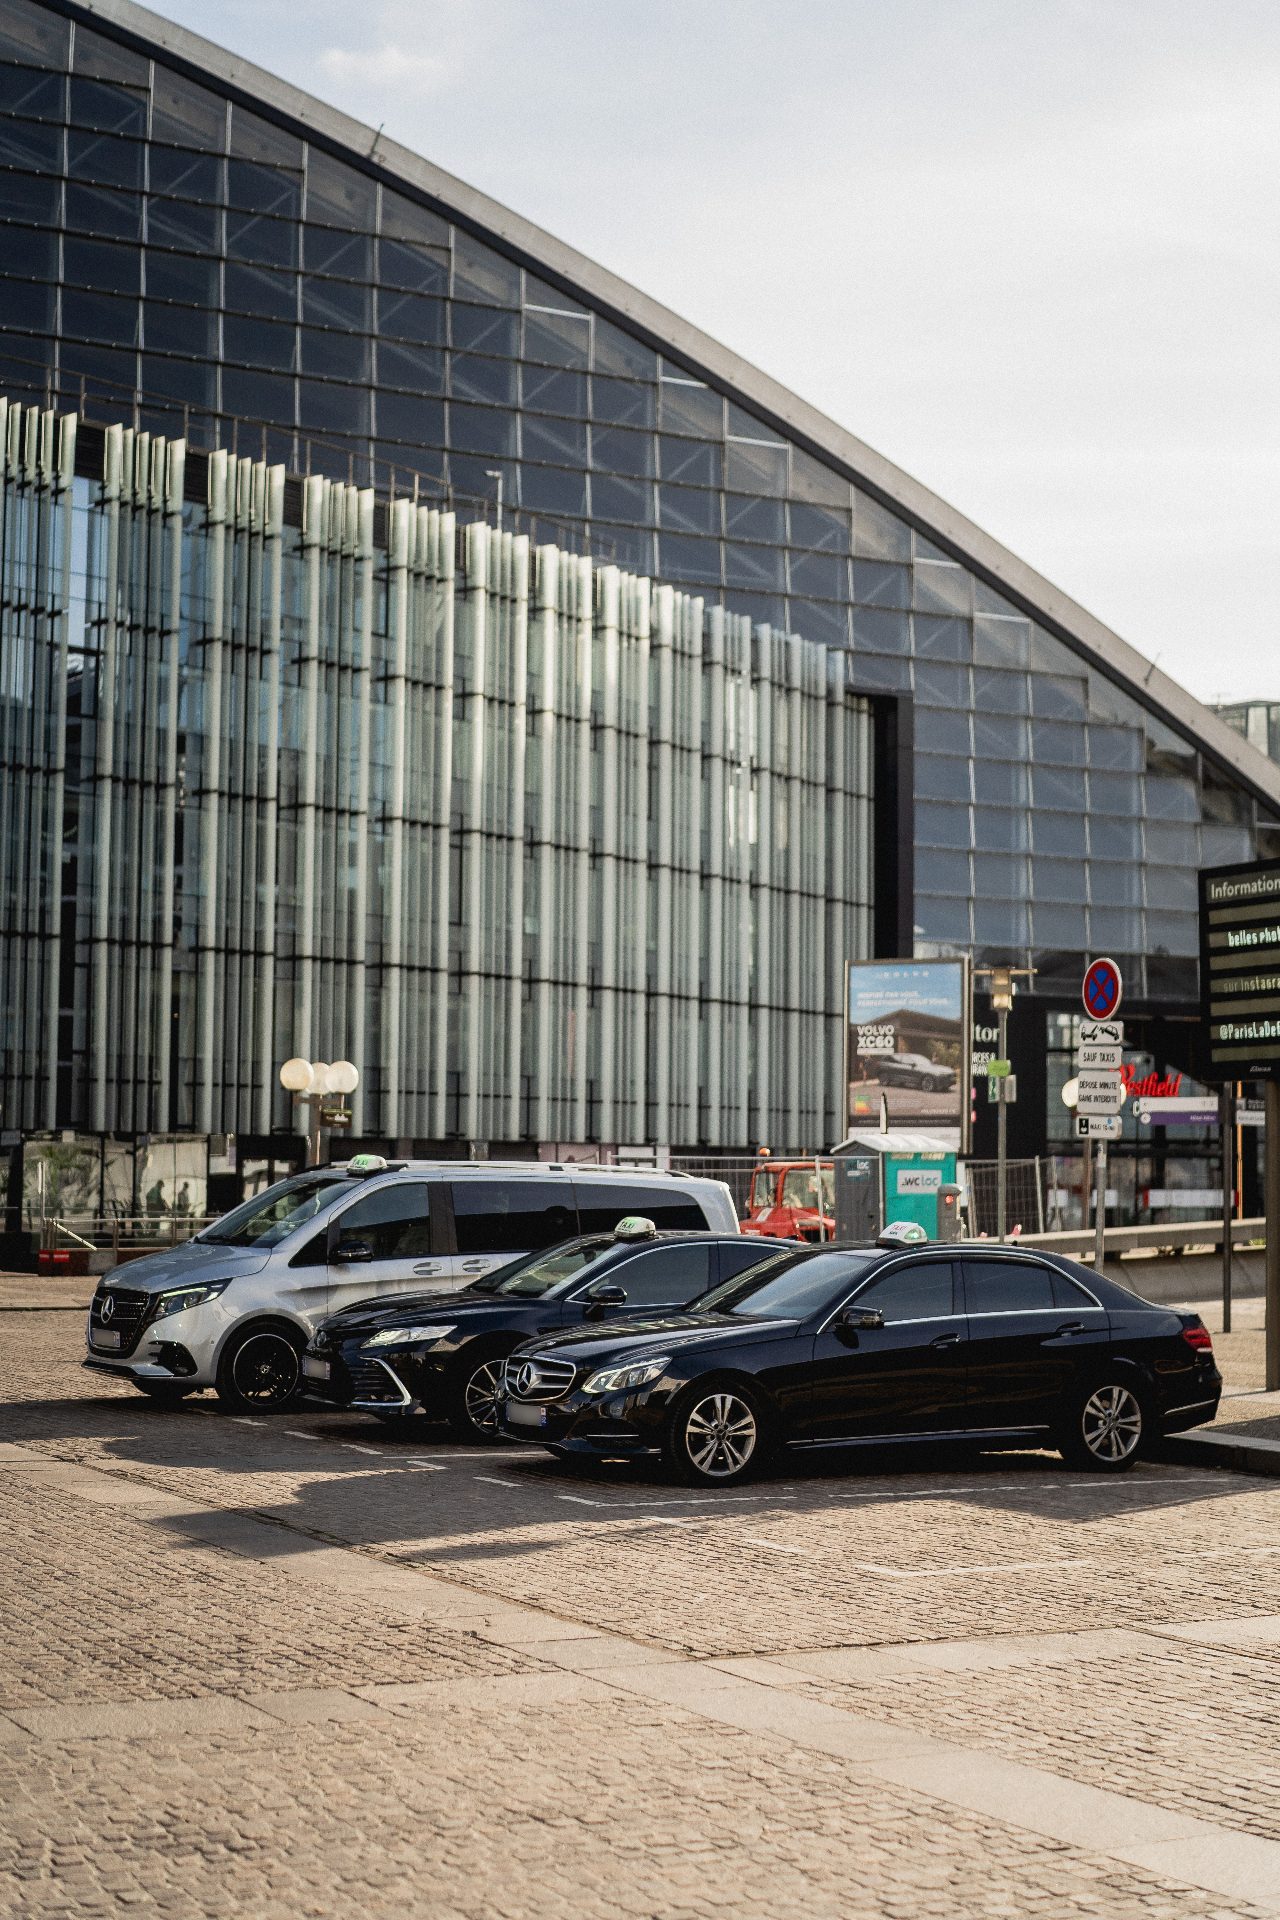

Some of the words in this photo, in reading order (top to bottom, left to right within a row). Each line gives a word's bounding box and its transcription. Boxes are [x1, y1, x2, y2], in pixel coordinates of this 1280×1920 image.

[1211, 874, 1280, 899] Information
[1228, 929, 1258, 947] belles
[1223, 981, 1239, 994] sur
[857, 1025, 894, 1036] VOLVO
[857, 1036, 894, 1048] XC60
[1083, 1051, 1098, 1062] SAUF
[1099, 1052, 1116, 1063] TAXIS
[1098, 1081, 1118, 1091] MINUTE
[921, 1175, 938, 1186] loc
[620, 1221, 636, 1229] TAXI
